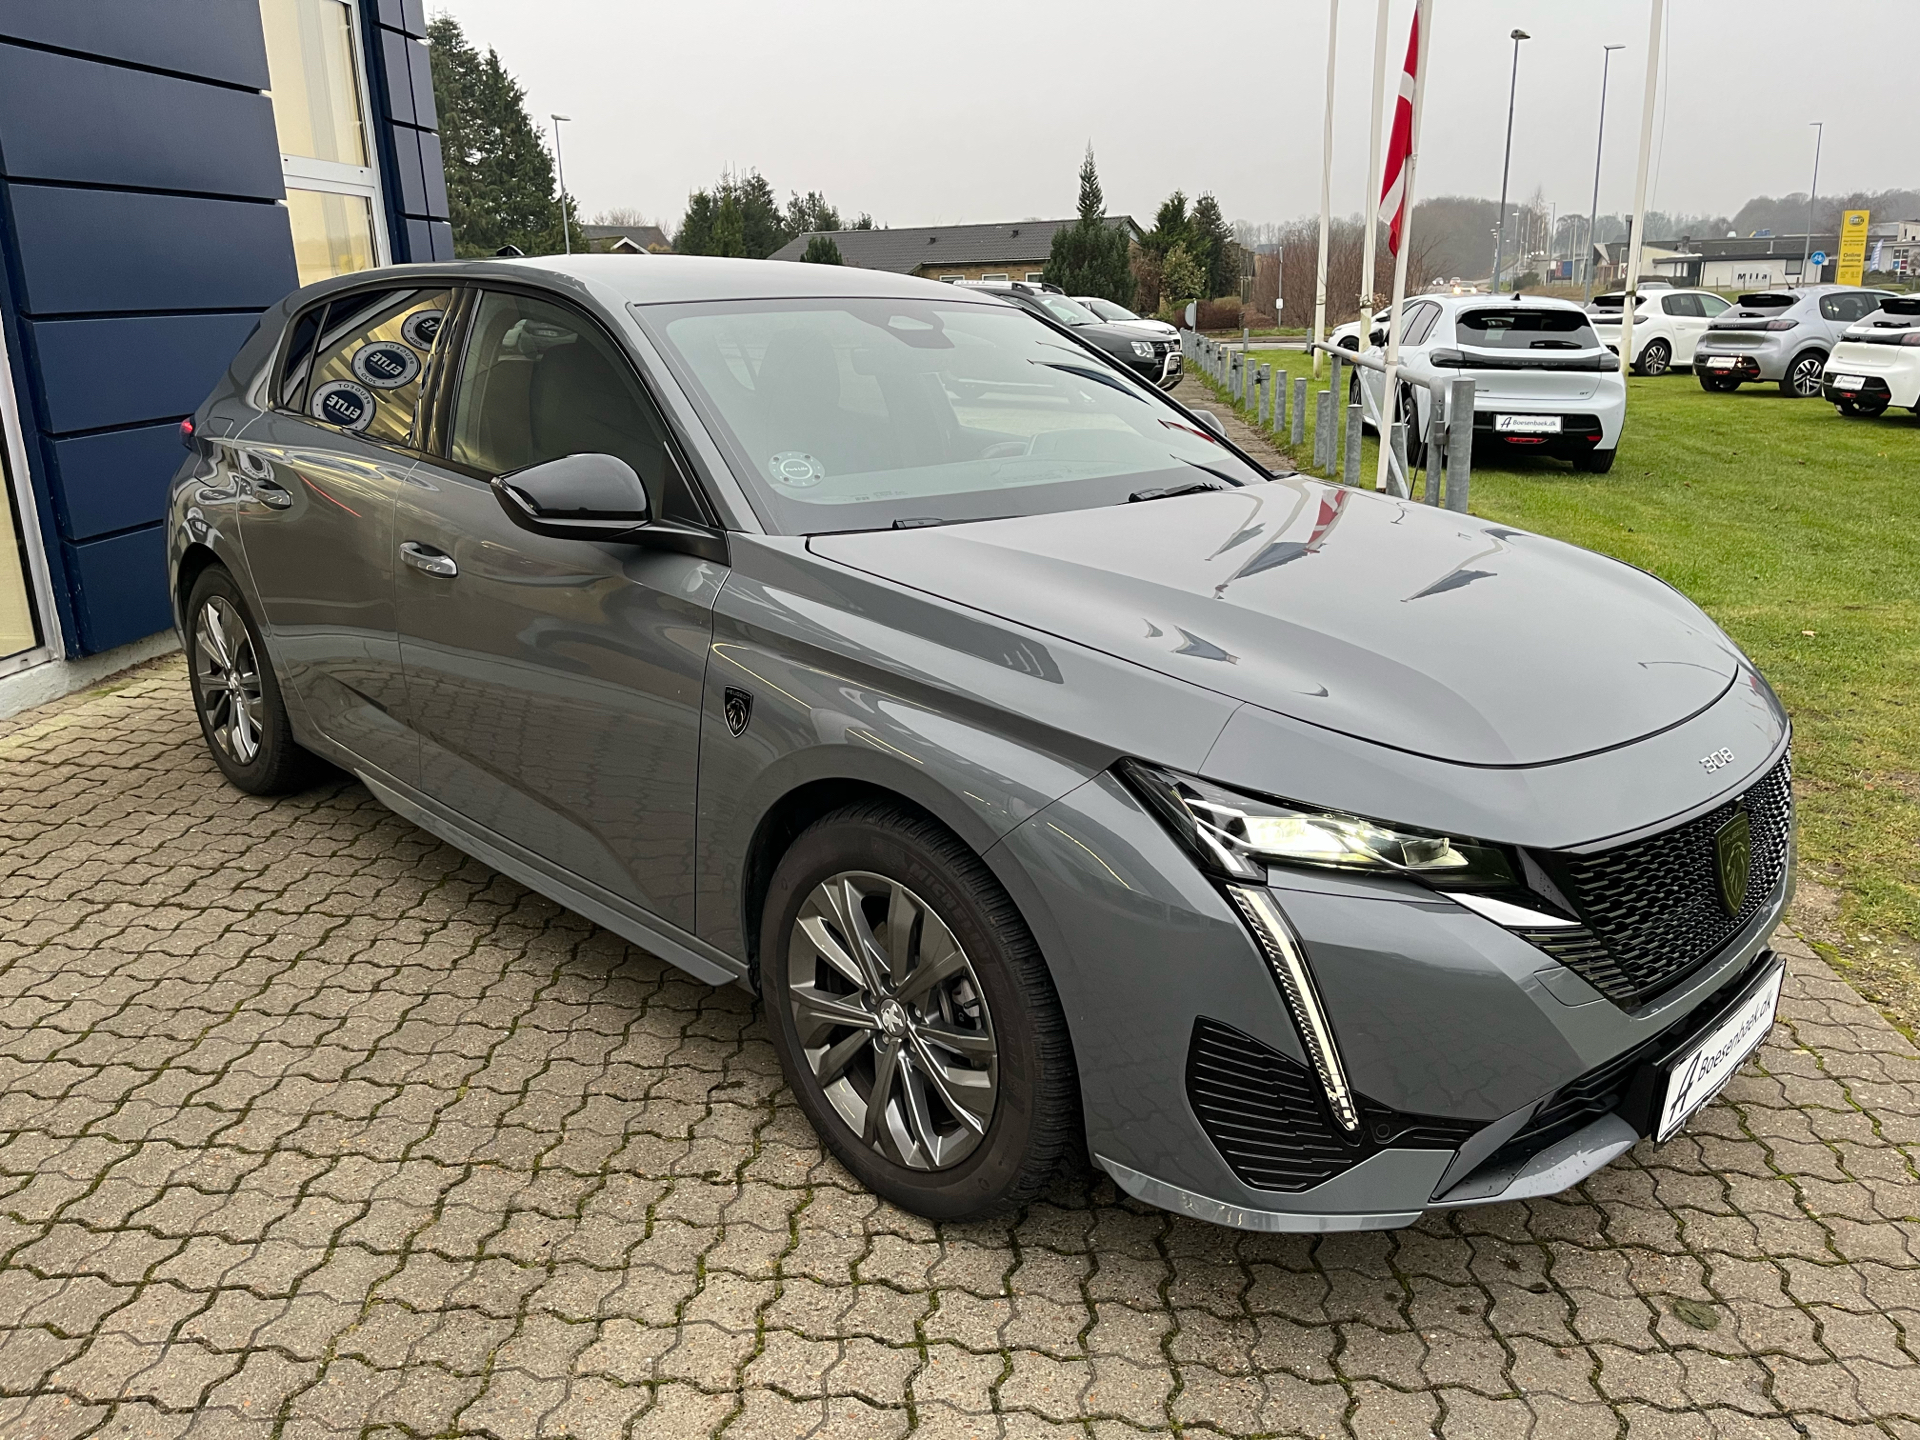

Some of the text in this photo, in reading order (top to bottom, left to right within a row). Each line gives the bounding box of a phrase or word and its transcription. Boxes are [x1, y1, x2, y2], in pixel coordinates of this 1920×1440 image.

[1512, 419, 1557, 427] Boesenbaek.dk
[1699, 746, 1735, 774] 308
[911, 864, 990, 961] MICHELIN
[1697, 988, 1774, 1083] Boesenbaek.dk
